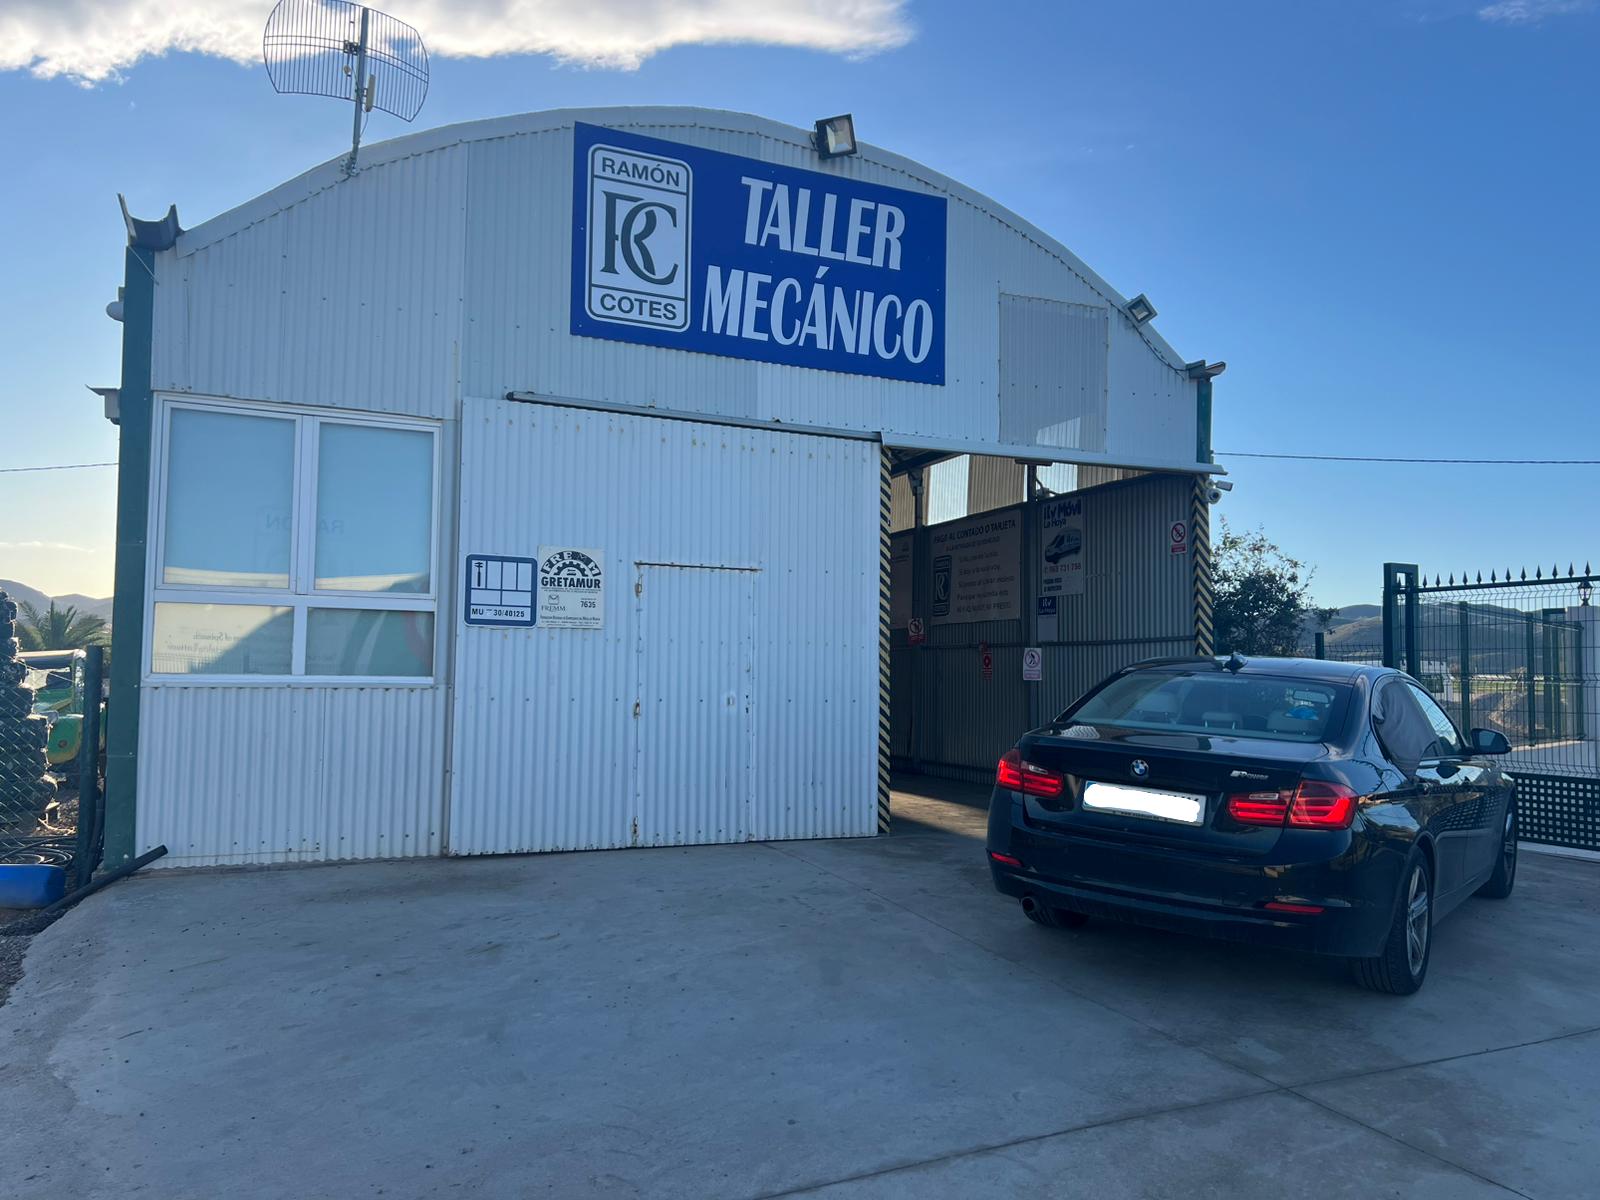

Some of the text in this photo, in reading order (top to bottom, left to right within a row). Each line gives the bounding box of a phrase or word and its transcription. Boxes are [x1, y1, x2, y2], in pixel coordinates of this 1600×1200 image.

[601, 156, 680, 187] RAMÓN
[741, 175, 906, 271] TALLER
[600, 292, 677, 321] COTES
[702, 264, 934, 364] MECÁNICO
[957, 526, 984, 540] CONTADO
[991, 520, 1016, 532] TARJETA
[541, 576, 601, 589] GRETAMUR
